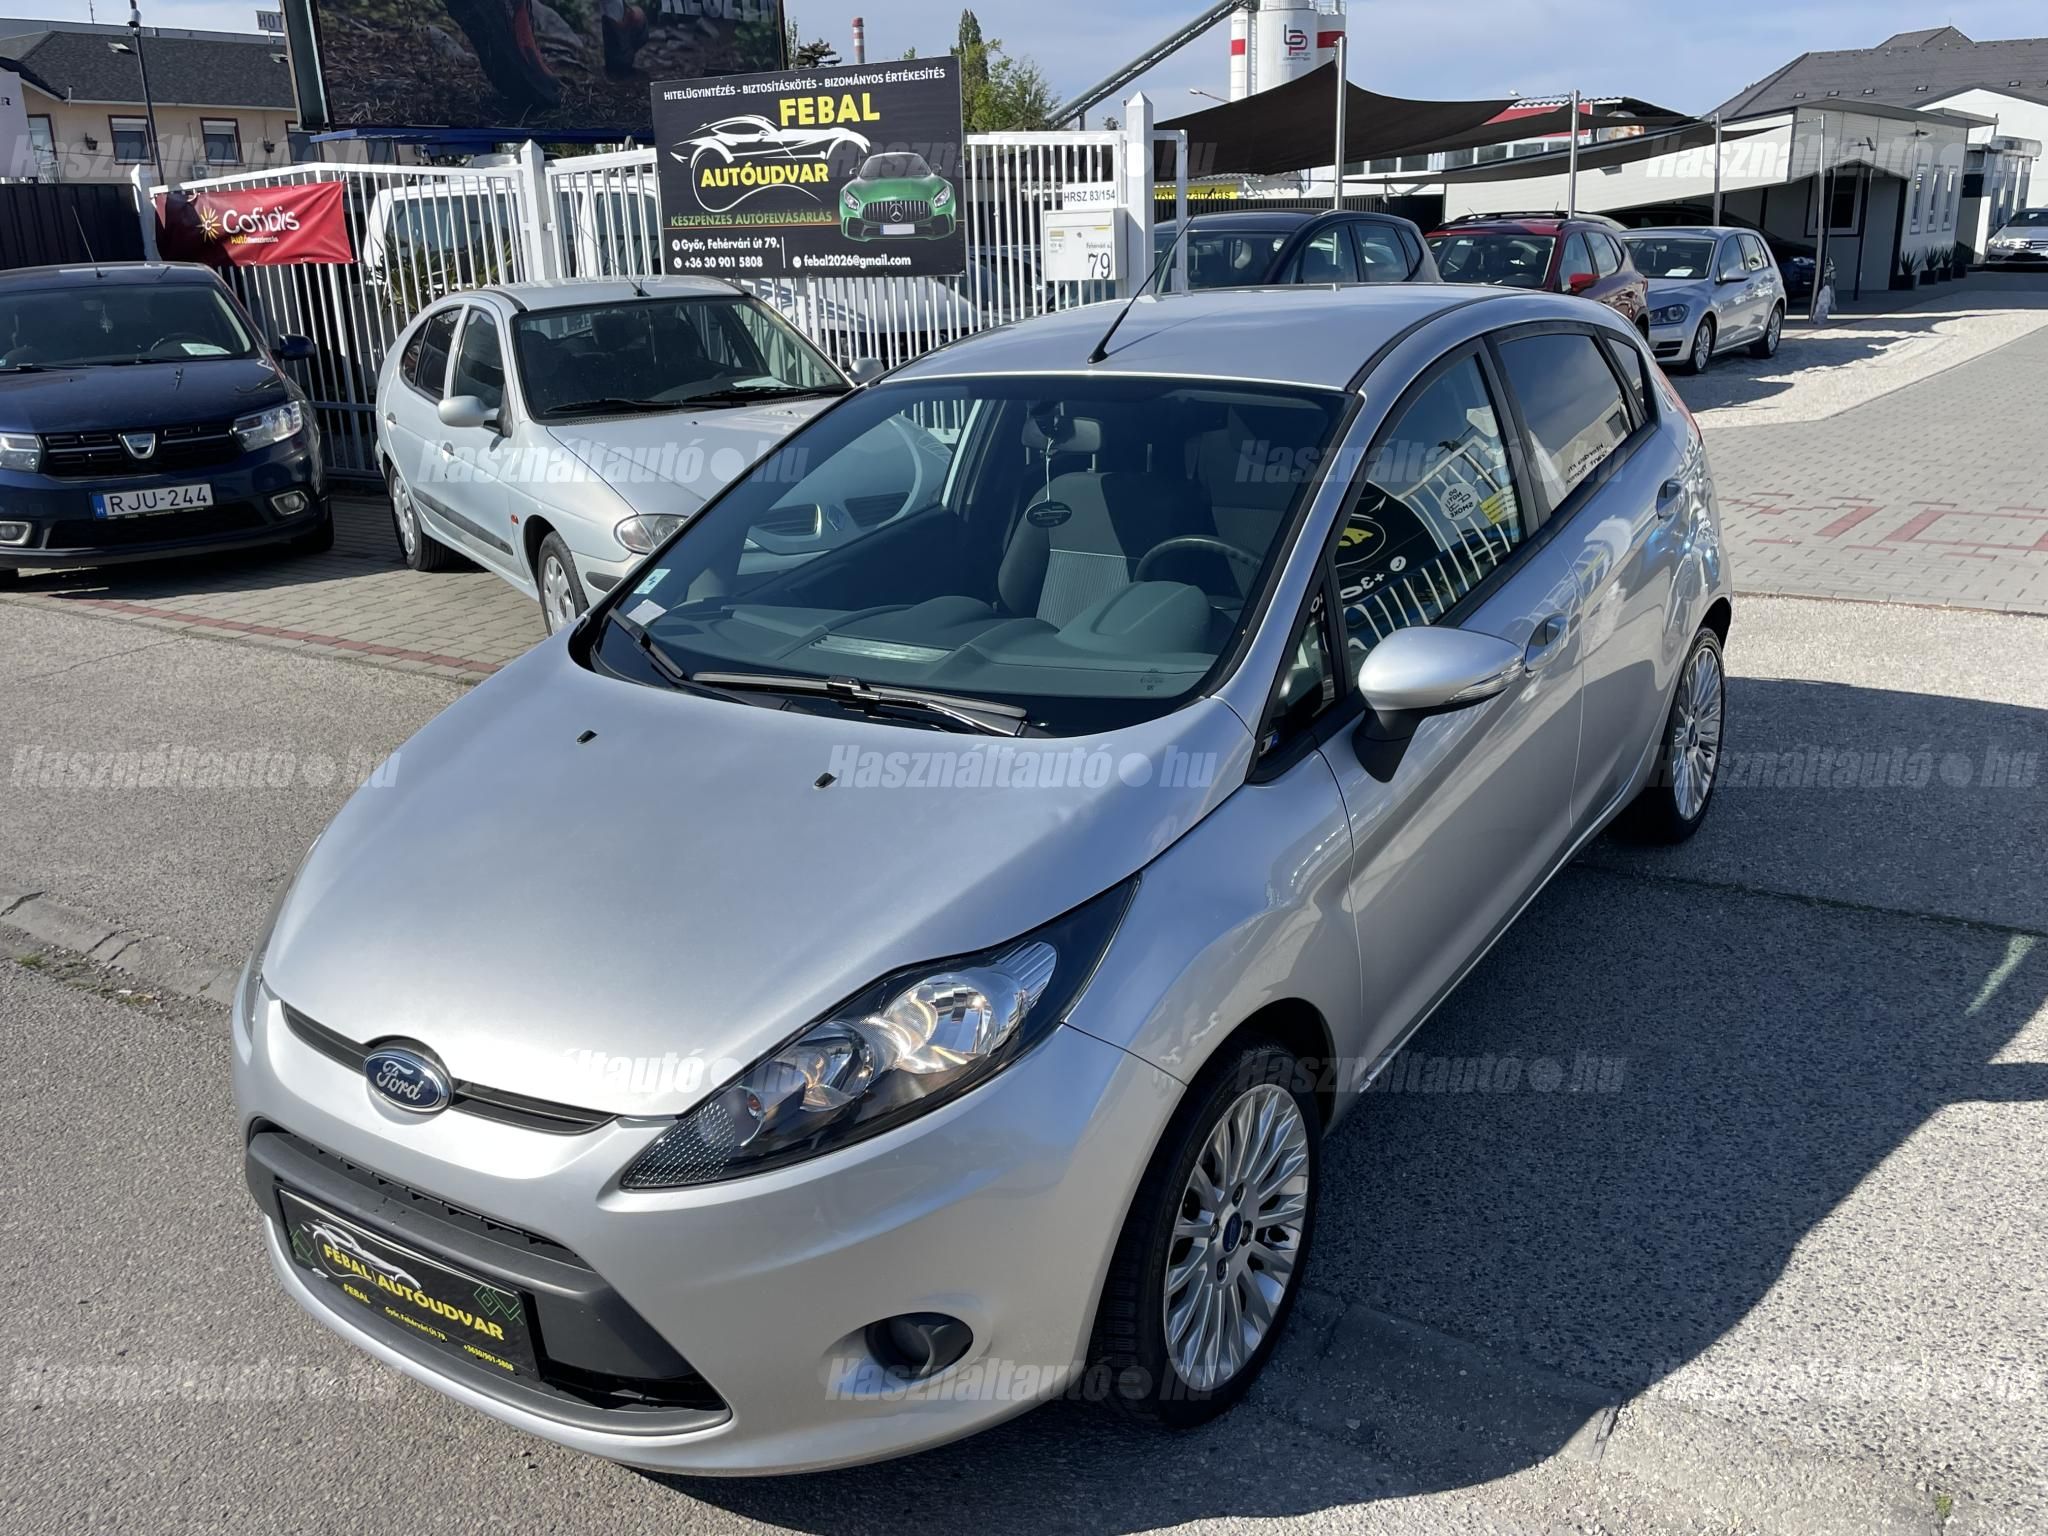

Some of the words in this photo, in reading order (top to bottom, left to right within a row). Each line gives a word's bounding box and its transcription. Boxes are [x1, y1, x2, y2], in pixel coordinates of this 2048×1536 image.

[663, 85, 736, 101] HITELÜGYINTÉZÉS
[742, 78, 817, 94] BIZTOSÍTÁSKÖTÉS
[824, 73, 883, 88] BIZOMÁNYOS
[885, 68, 946, 83] ÉRTÉKESÍTÉS
[779, 93, 880, 127] FEBAL
[700, 162, 829, 188] AUTÓUDVAR
[1064, 191, 1087, 202] HRSZ
[1089, 190, 1116, 201] 83/154
[222, 206, 300, 234] Cofidis
[671, 213, 733, 227] KÉSZPÉNZES
[735, 210, 832, 225] AUTÓFELVÁSÁRLÁS
[681, 239, 706, 252] Győr,
[707, 237, 751, 250] Fehérvári
[753, 238, 763, 249] út
[764, 237, 780, 249] 79.
[684, 257, 702, 269] +36
[704, 257, 717, 268] 30
[718, 257, 736, 268] 901
[738, 256, 763, 268] 5808
[803, 254, 911, 269] febal2026@gmail.com
[1087, 252, 1112, 279] 79
[109, 488, 207, 513] RJU-244
[376, 1060, 425, 1101] Ford
[323, 1243, 373, 1281] FEBAL
[343, 1283, 371, 1304] FEBAL
[378, 1274, 505, 1341] AUTÓUDVAR
